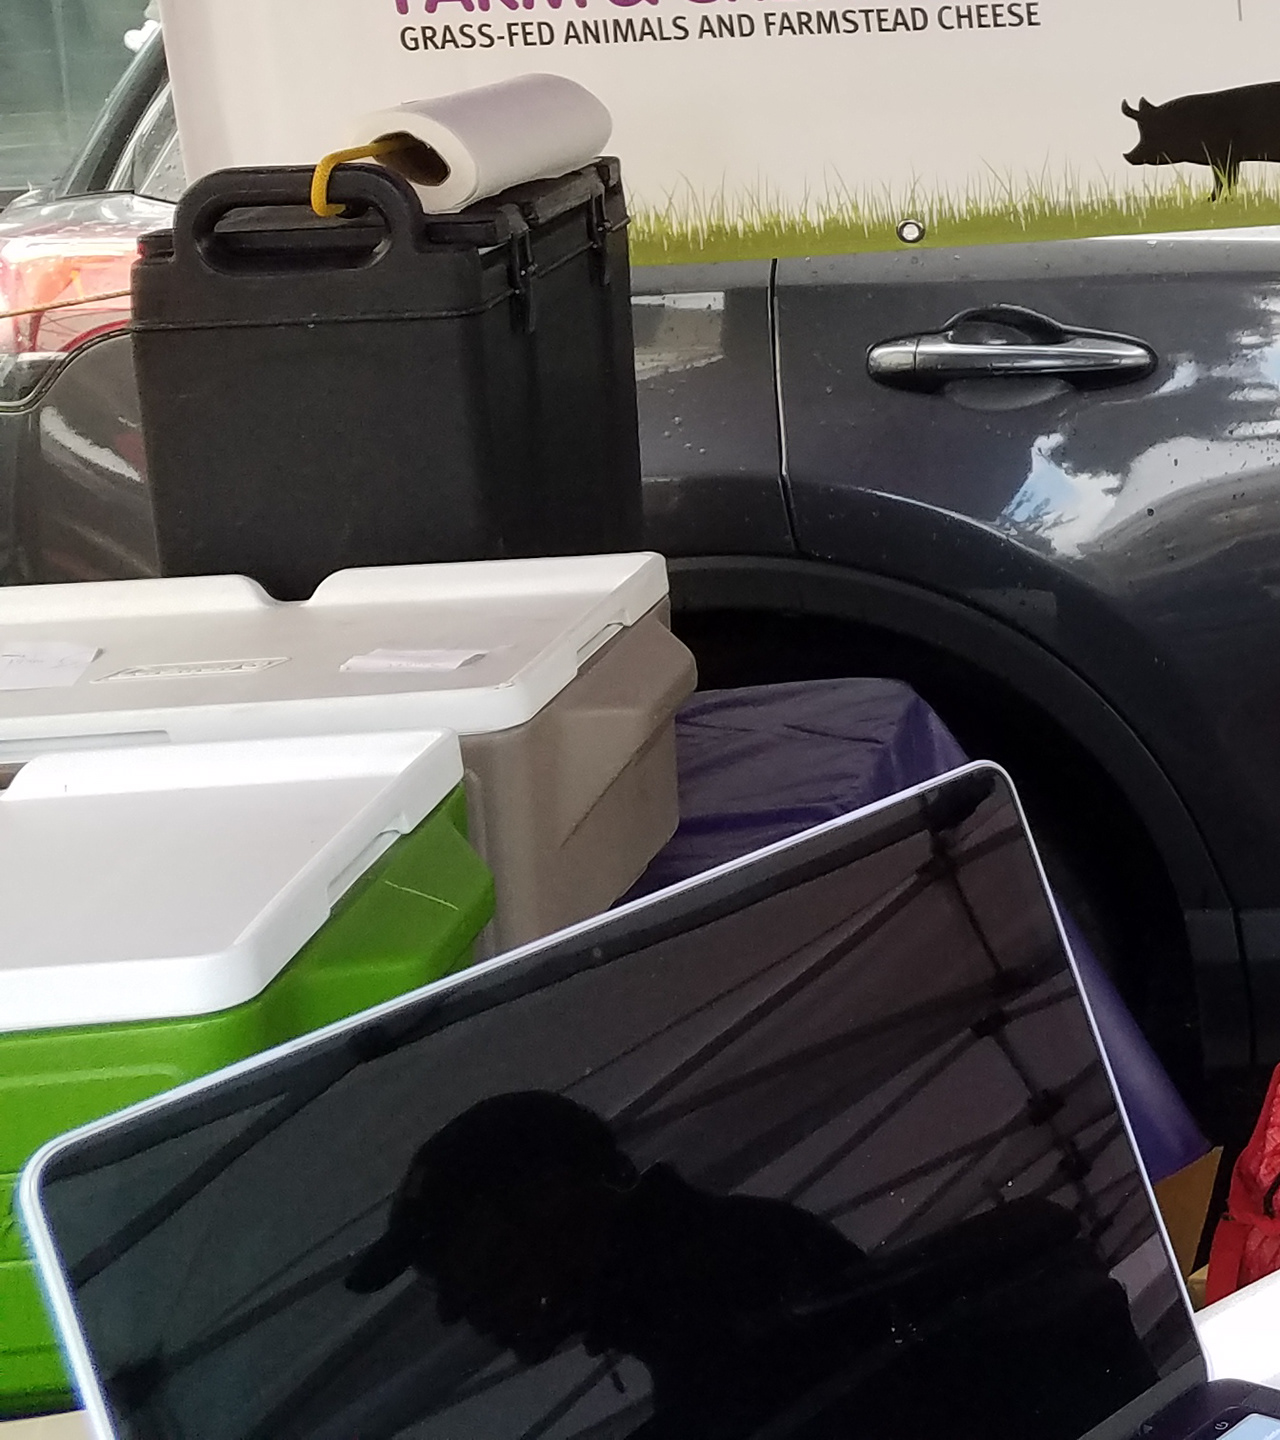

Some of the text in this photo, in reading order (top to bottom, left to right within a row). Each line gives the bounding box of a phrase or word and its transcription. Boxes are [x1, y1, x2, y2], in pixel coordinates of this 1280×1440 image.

[400, 2, 1041, 51] GRASS-FED ANIMALS AND FARMSTEAD CHEESE
